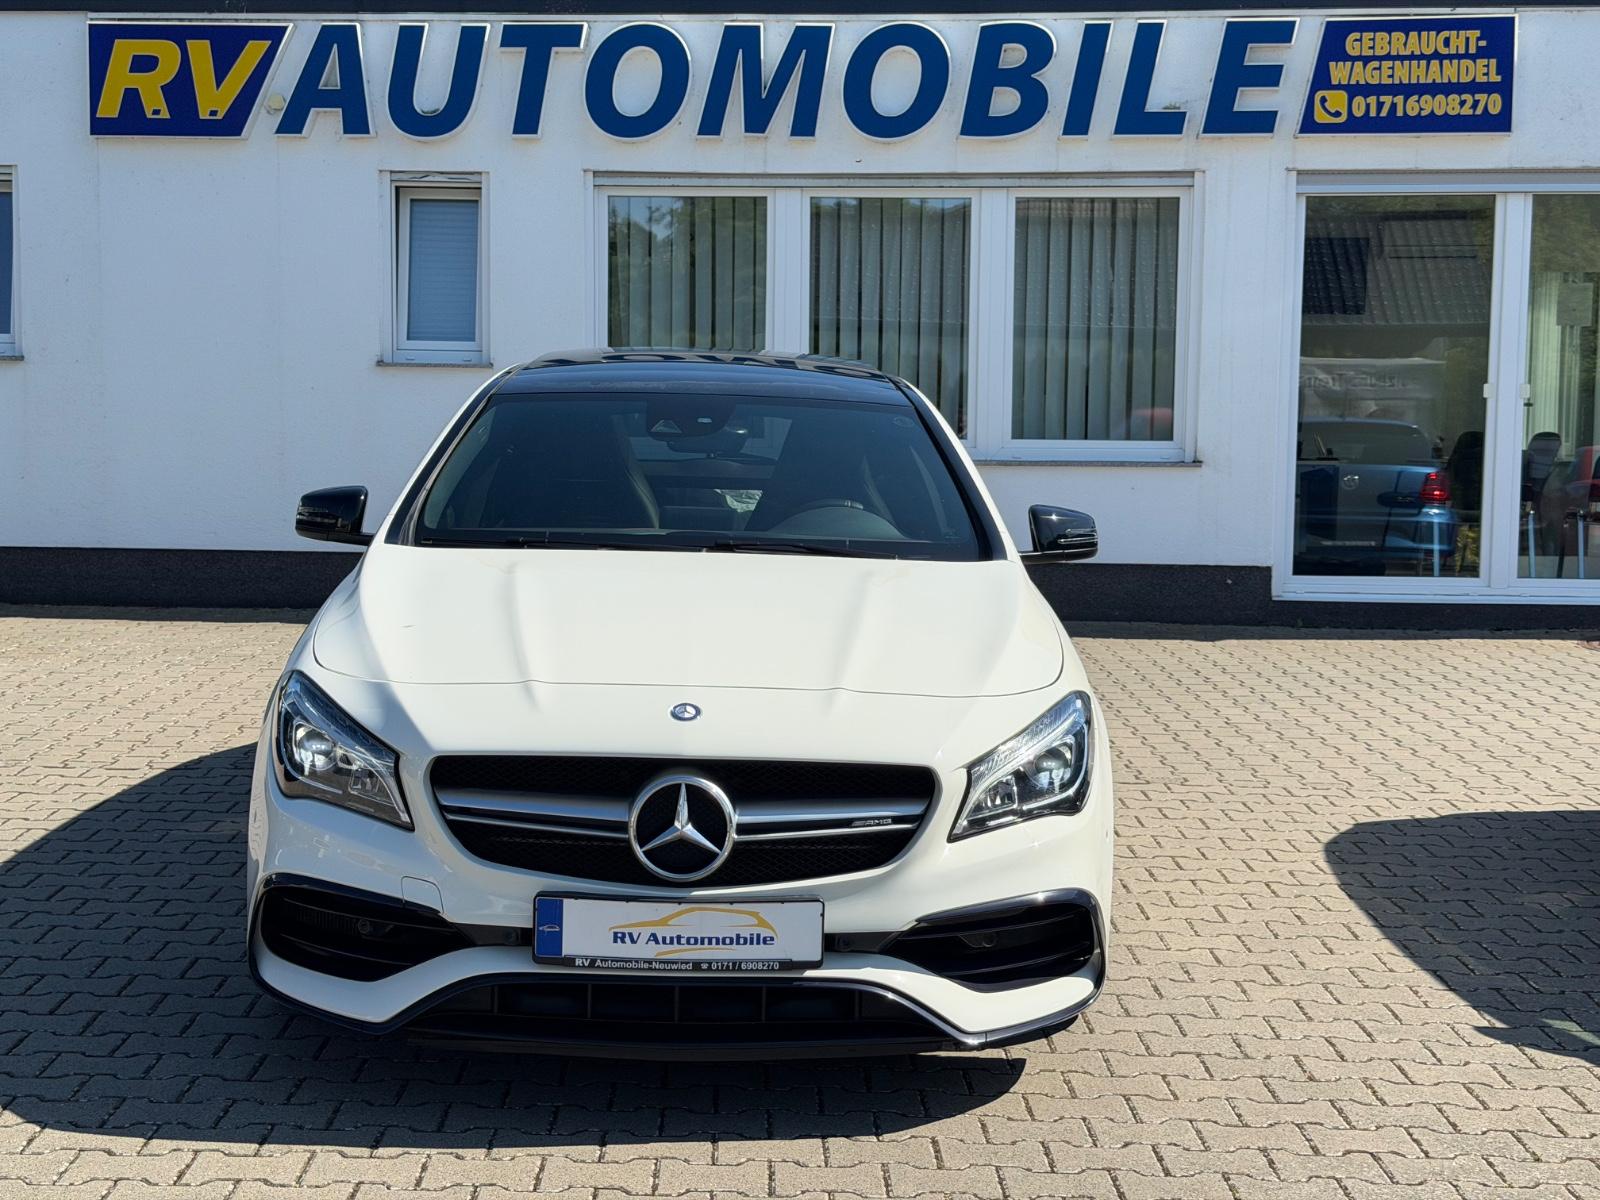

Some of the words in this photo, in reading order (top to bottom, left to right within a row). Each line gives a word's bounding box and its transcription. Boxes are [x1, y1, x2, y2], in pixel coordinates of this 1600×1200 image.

[1345, 30, 1487, 56] GEBRAUCHT-
[95, 39, 272, 120] RV
[273, 19, 1299, 140] AUTOMOBILE
[1329, 58, 1501, 85] WAGENHANDEL
[1352, 93, 1502, 117] 01716908270
[612, 931, 642, 945] RV
[645, 932, 775, 946] Automobile
[575, 958, 591, 967] RV
[595, 959, 693, 970] Automobile-Neuwied
[711, 962, 733, 970] 0171
[741, 962, 780, 971] 6908270
